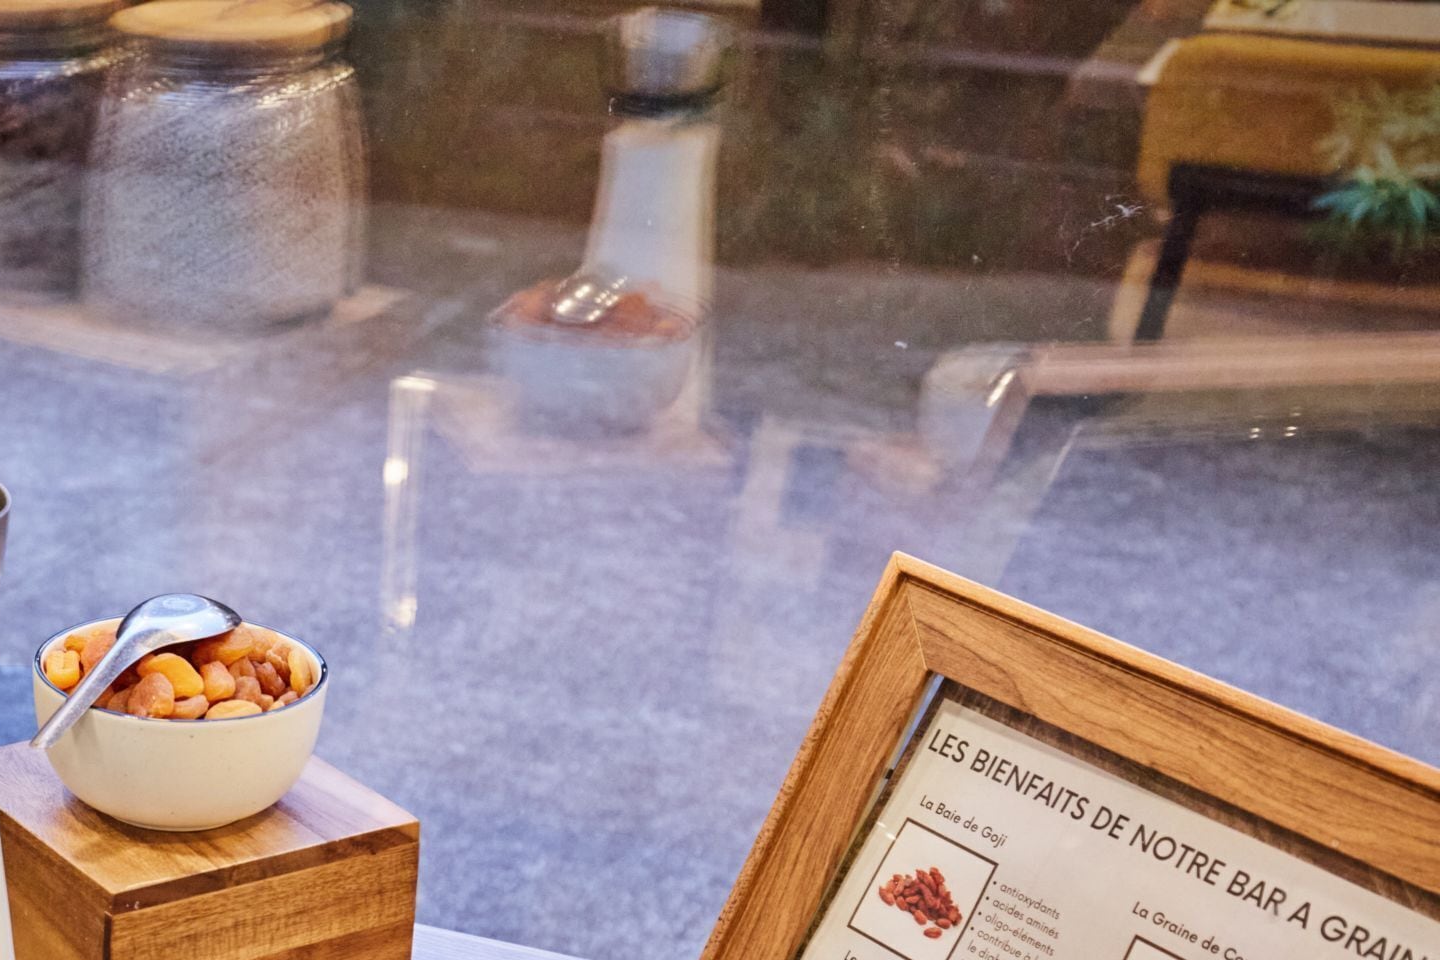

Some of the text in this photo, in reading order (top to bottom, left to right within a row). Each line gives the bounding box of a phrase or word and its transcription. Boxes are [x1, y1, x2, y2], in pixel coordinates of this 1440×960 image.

[920, 795, 1008, 848] La Baie de Goji
[927, 728, 968, 764] LES
[970, 748, 1091, 821] BIENFAITS
[1090, 805, 1130, 840] DE
[1129, 824, 1227, 886] NOTRE
[1227, 870, 1287, 916] BAR
[1287, 902, 1311, 930] A
[992, 900, 1059, 940] acides aminés
[1000, 883, 1060, 920] antioxydants
[967, 942, 976, 954] le
[977, 928, 1021, 957] contribue
[985, 914, 1055, 957] oligo-éléments
[1132, 901, 1149, 919] La
[1152, 912, 1199, 944] Graine
[1201, 936, 1220, 954] de
